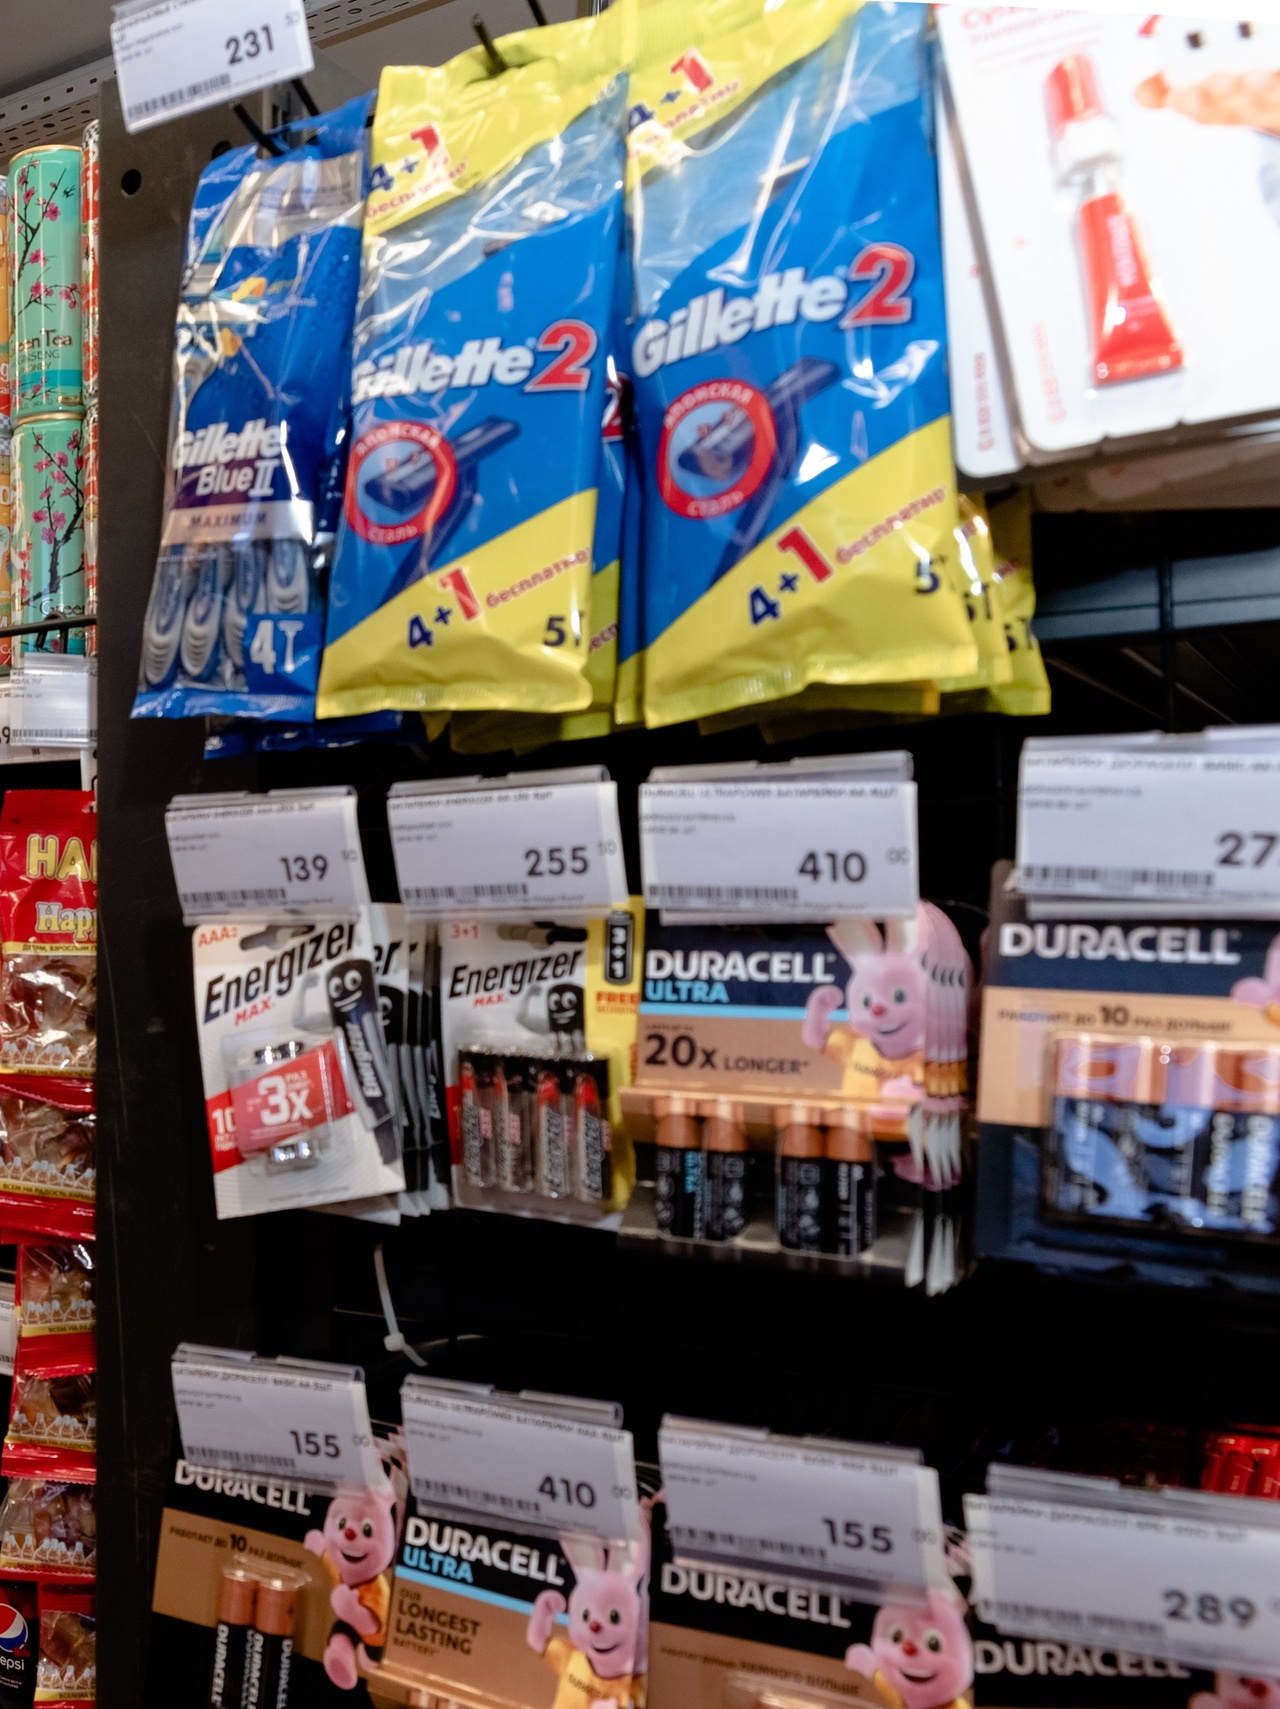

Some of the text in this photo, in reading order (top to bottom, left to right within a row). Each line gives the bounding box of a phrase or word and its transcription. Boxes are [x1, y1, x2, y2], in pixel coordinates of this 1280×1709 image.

[226, 24, 274, 65] 231
[632, 242, 915, 378] Gillette 2
[42, 329, 73, 347] Tea
[352, 318, 597, 405] Gillette 2
[173, 418, 284, 469] Gillette
[196, 463, 253, 497] Blue
[189, 513, 267, 527] MAXIMUM
[370, 525, 418, 543] СТАЛЬ
[524, 847, 589, 878] 255
[1217, 832, 1280, 867] 27
[279, 855, 329, 883] 139
[797, 850, 868, 885] 410
[999, 923, 1241, 965] DURACELL
[204, 923, 355, 1024] Energizer
[448, 950, 582, 1001] Energizer
[645, 949, 836, 984] DURACELL
[596, 992, 639, 1004] FREE
[646, 980, 730, 1004] ULTRA
[233, 998, 271, 1026] MAX
[1100, 1004, 1130, 1028] 10
[289, 1430, 341, 1460] 155
[537, 1475, 597, 1509] 410
[229, 1532, 247, 1553] 10
[406, 1517, 565, 1586] DURACELL
[821, 1517, 893, 1555] 155
[403, 1545, 473, 1583] ULTRA
[660, 1564, 851, 1629] DURACELL
[1163, 1588, 1258, 1629] 289
[398, 1600, 480, 1637] LONGEST
[395, 1618, 473, 1656] LASTING
[973, 1640, 1192, 1678] DURACELL
